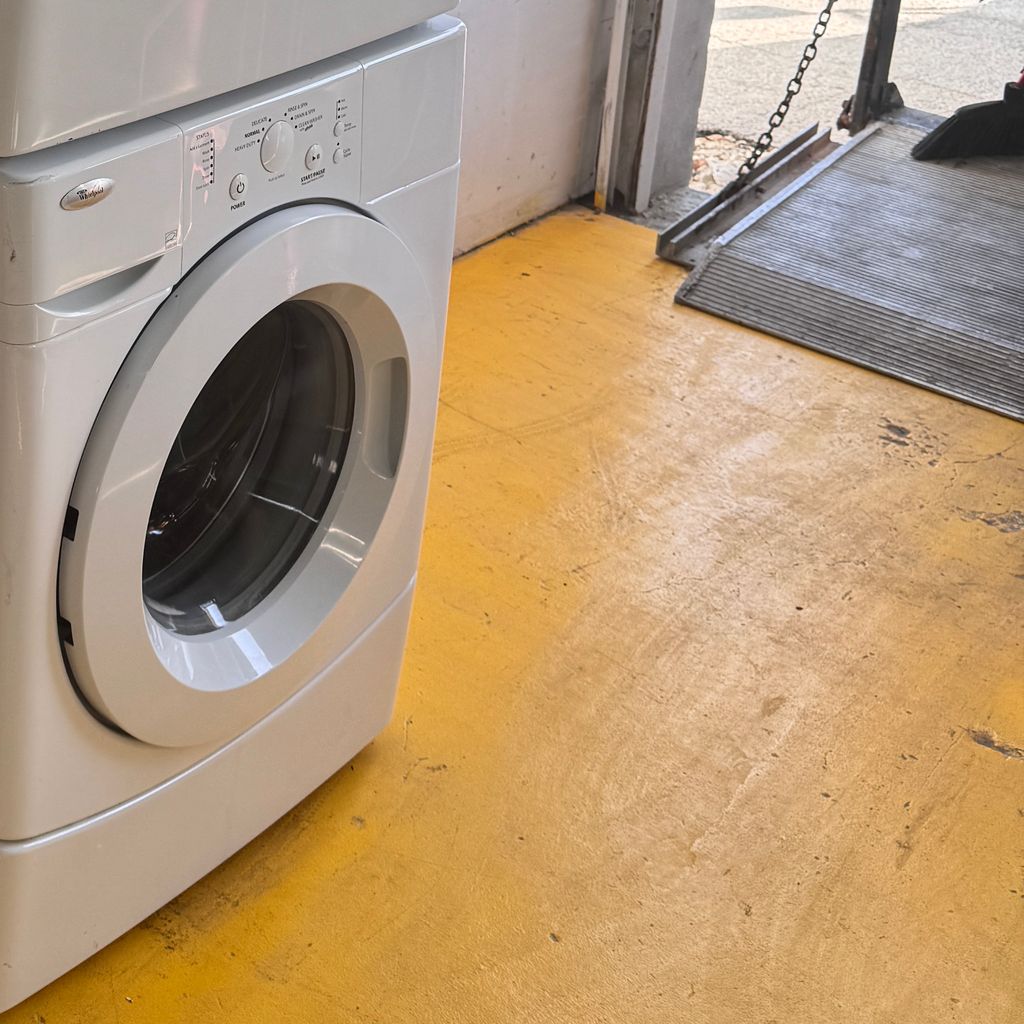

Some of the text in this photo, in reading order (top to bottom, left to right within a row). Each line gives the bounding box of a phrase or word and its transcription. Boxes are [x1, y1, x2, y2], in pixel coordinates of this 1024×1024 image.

[244, 129, 260, 138] NORMAL
[79, 186, 104, 200] Whirlpool
[230, 201, 246, 211] POWER
